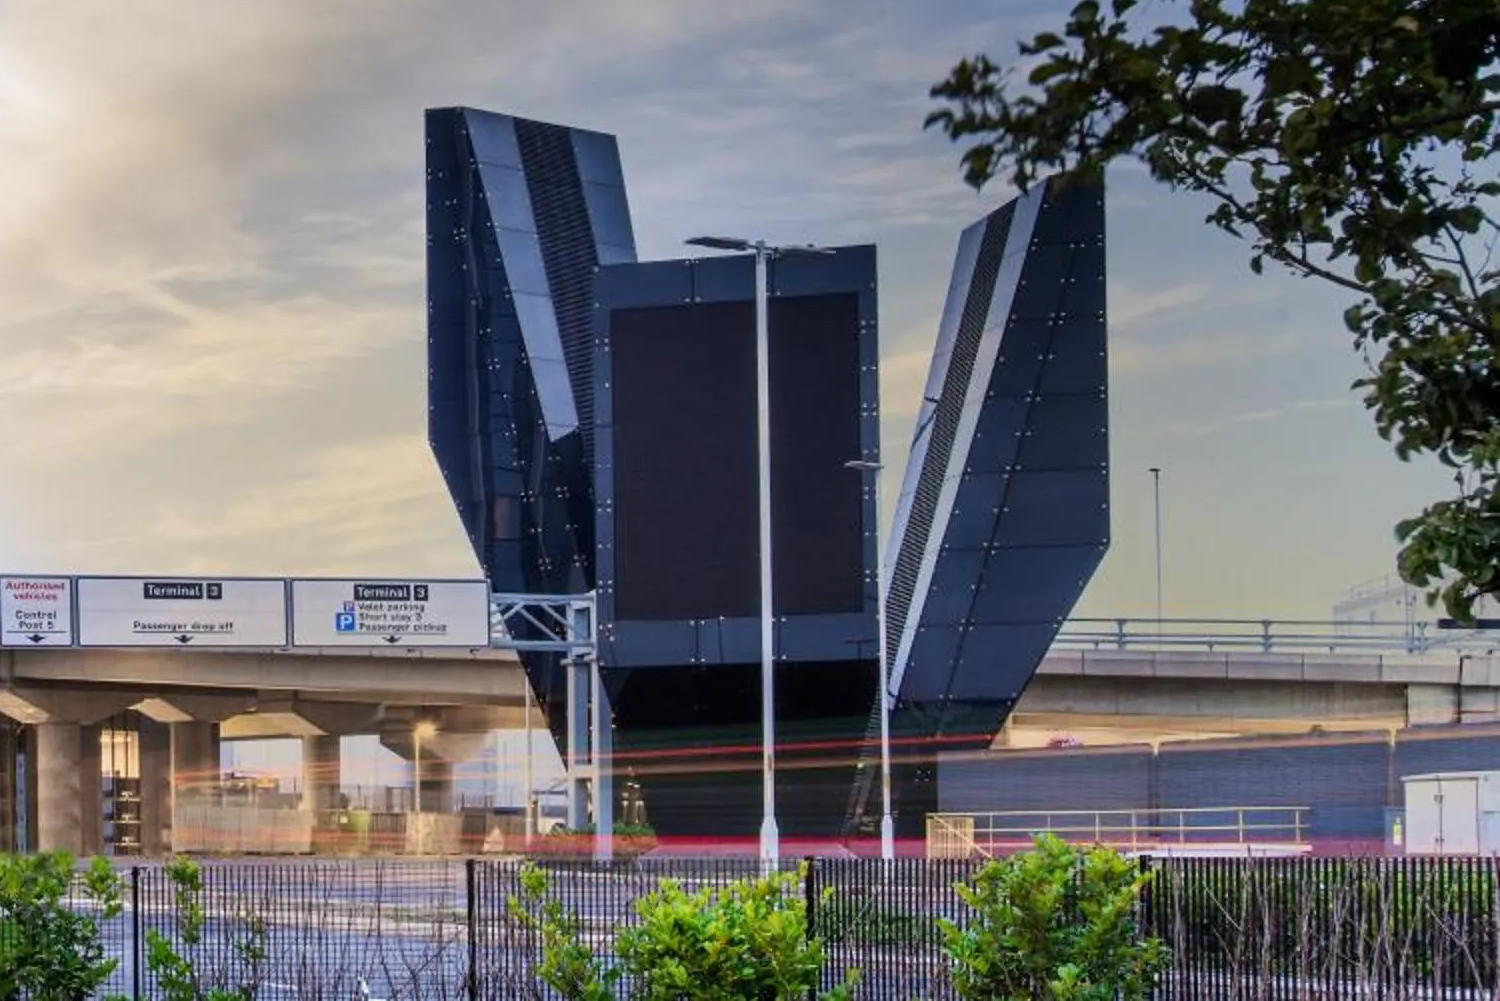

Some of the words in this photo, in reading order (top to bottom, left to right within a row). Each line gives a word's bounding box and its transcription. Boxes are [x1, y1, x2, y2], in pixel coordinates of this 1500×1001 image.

[147, 584, 201, 597] Terminal
[356, 586, 409, 598] Terminal
[417, 587, 425, 598] 3
[13, 592, 58, 601] vehicles
[358, 603, 384, 612] Valet
[387, 602, 426, 613] parking
[15, 610, 57, 620] Control
[359, 613, 387, 621] Short
[390, 613, 412, 623] stay
[19, 621, 43, 630] Post
[133, 620, 188, 632] Passenger
[191, 621, 216, 632] drop
[219, 621, 234, 631] off
[340, 615, 353, 630] P
[358, 622, 411, 633] Passenger
[413, 622, 447, 633] pickup
